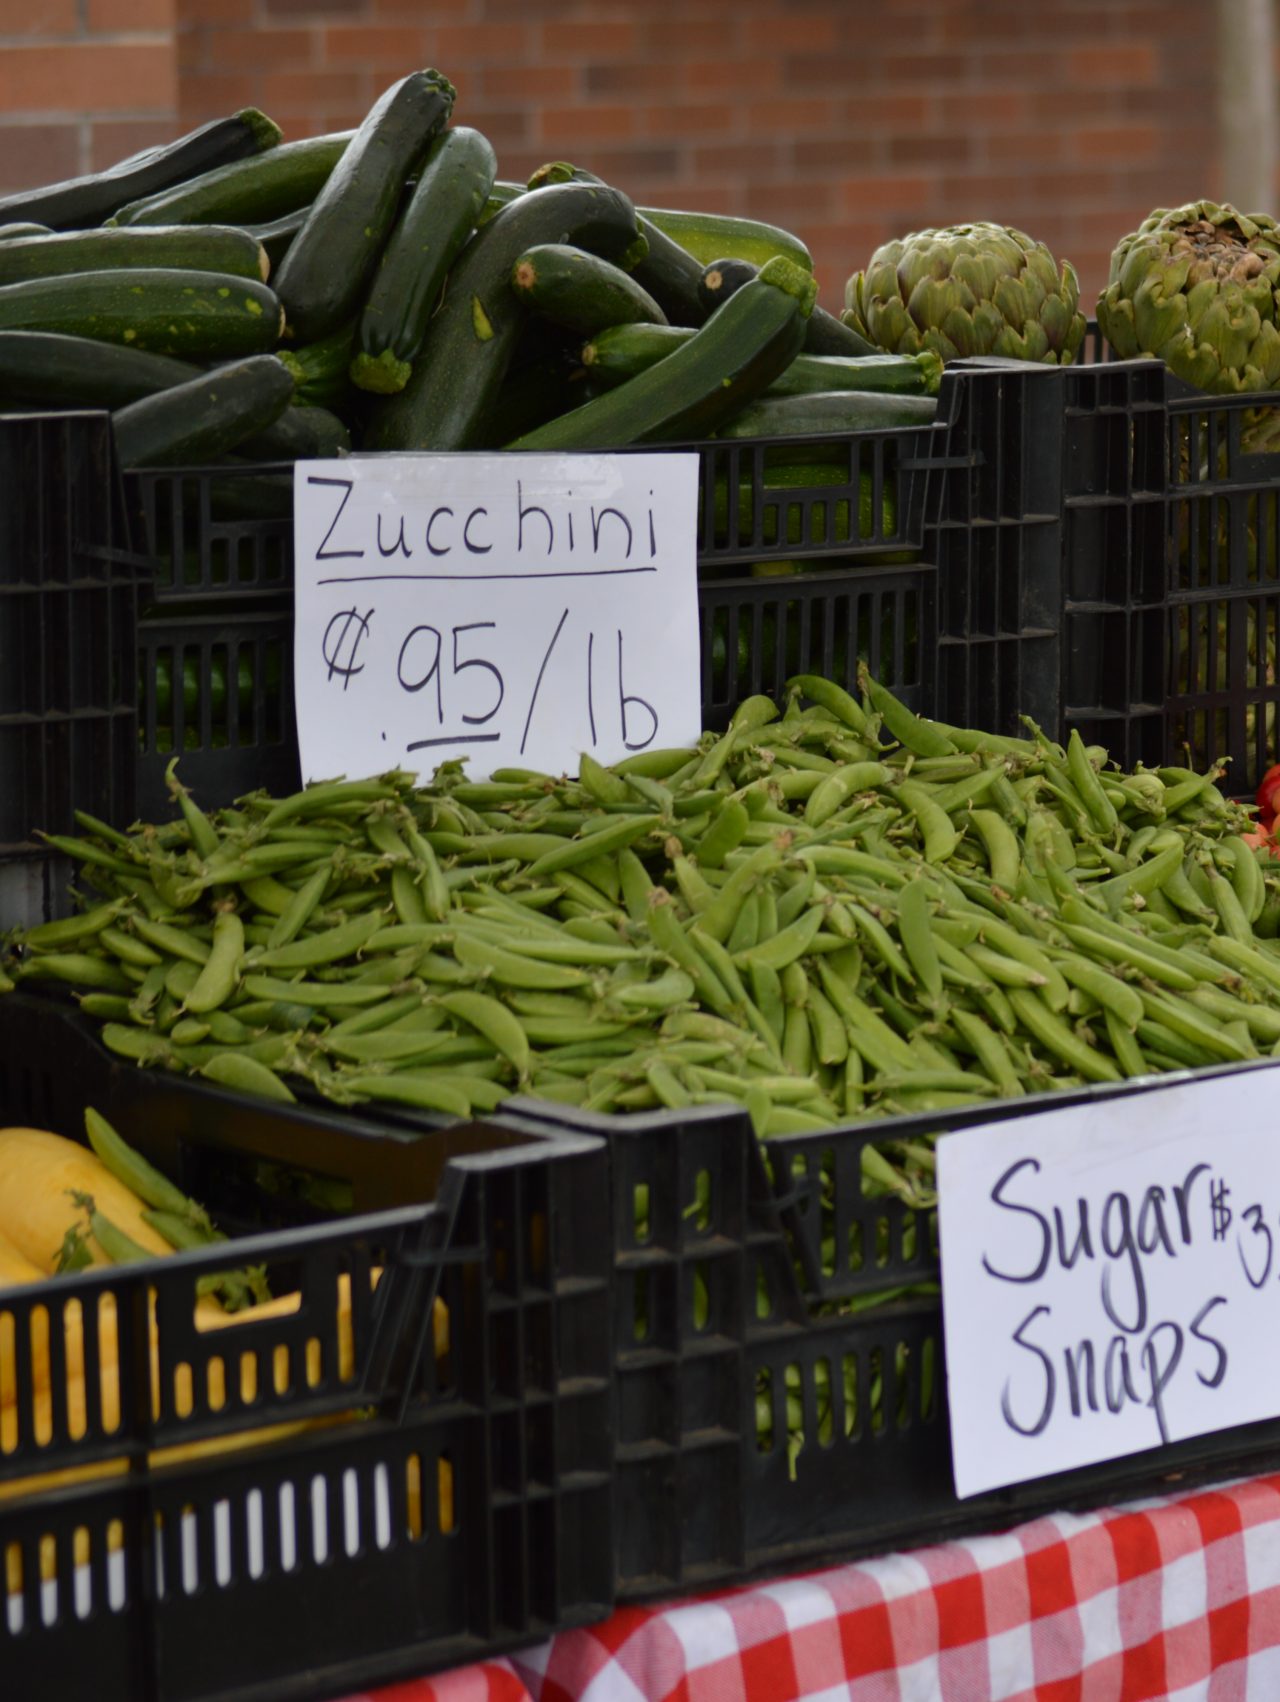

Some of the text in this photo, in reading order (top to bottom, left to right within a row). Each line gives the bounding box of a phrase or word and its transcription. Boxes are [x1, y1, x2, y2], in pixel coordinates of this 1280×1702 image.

[307, 475, 658, 560] Zucchini
[981, 1157, 1212, 1334] Sugar
[1000, 1295, 1229, 1444] Snaps
